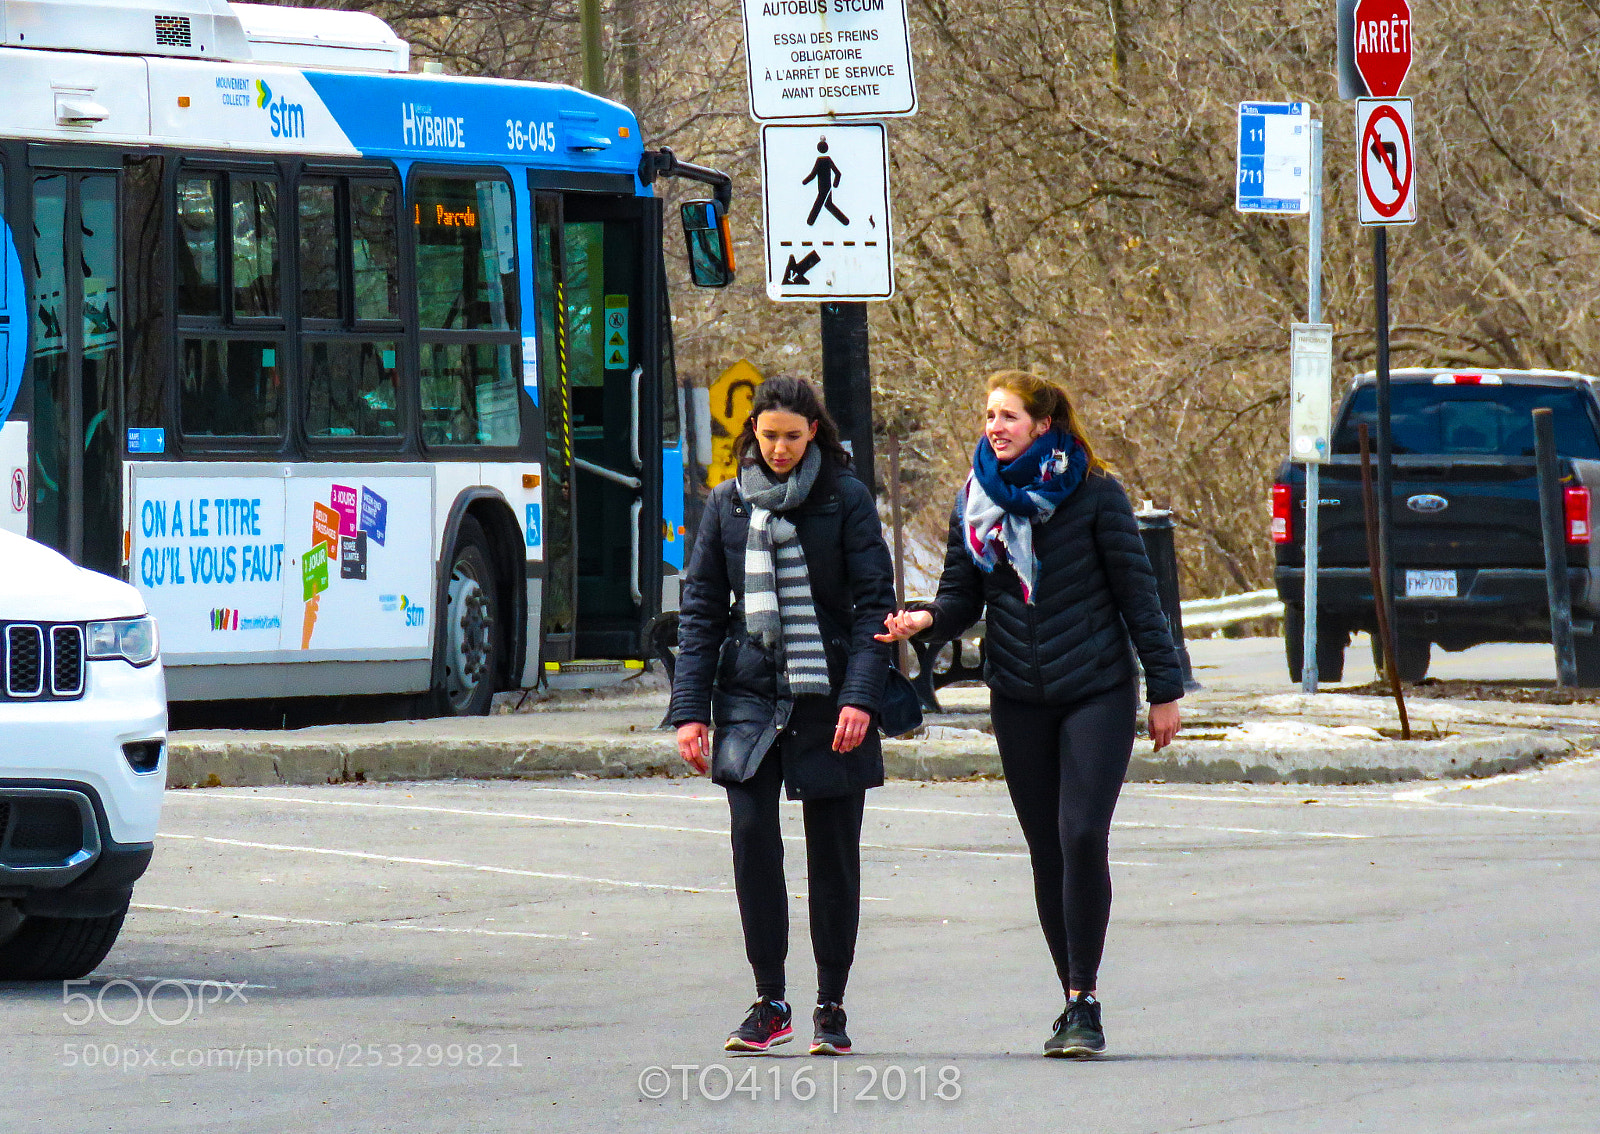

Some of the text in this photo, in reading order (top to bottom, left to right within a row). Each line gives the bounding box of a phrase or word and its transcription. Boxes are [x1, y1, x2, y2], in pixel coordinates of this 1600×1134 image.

[763, 0, 885, 16] AUTOBUS STCUM
[774, 29, 879, 46] ESSAI DES FREINS
[1358, 13, 1408, 54] ARRÊT
[790, 48, 863, 62] OBLIGATOIRE
[764, 64, 895, 81] À L'ARRÊT DE SERVICE
[215, 76, 250, 91] MOUVEMENT
[781, 84, 880, 99] AVANT DESCENTE
[222, 93, 250, 107] COLLECTIF
[269, 95, 305, 138] stm
[402, 102, 466, 148] HYBRIDE
[506, 119, 556, 152] 36-045
[1249, 128, 1263, 142] 11
[1240, 169, 1262, 184] 711
[142, 498, 261, 538] ON A LE TITRE
[141, 544, 284, 588] QU'IL VOUS FAUT
[309, 549, 326, 572] JOUR
[405, 603, 425, 627] stm
